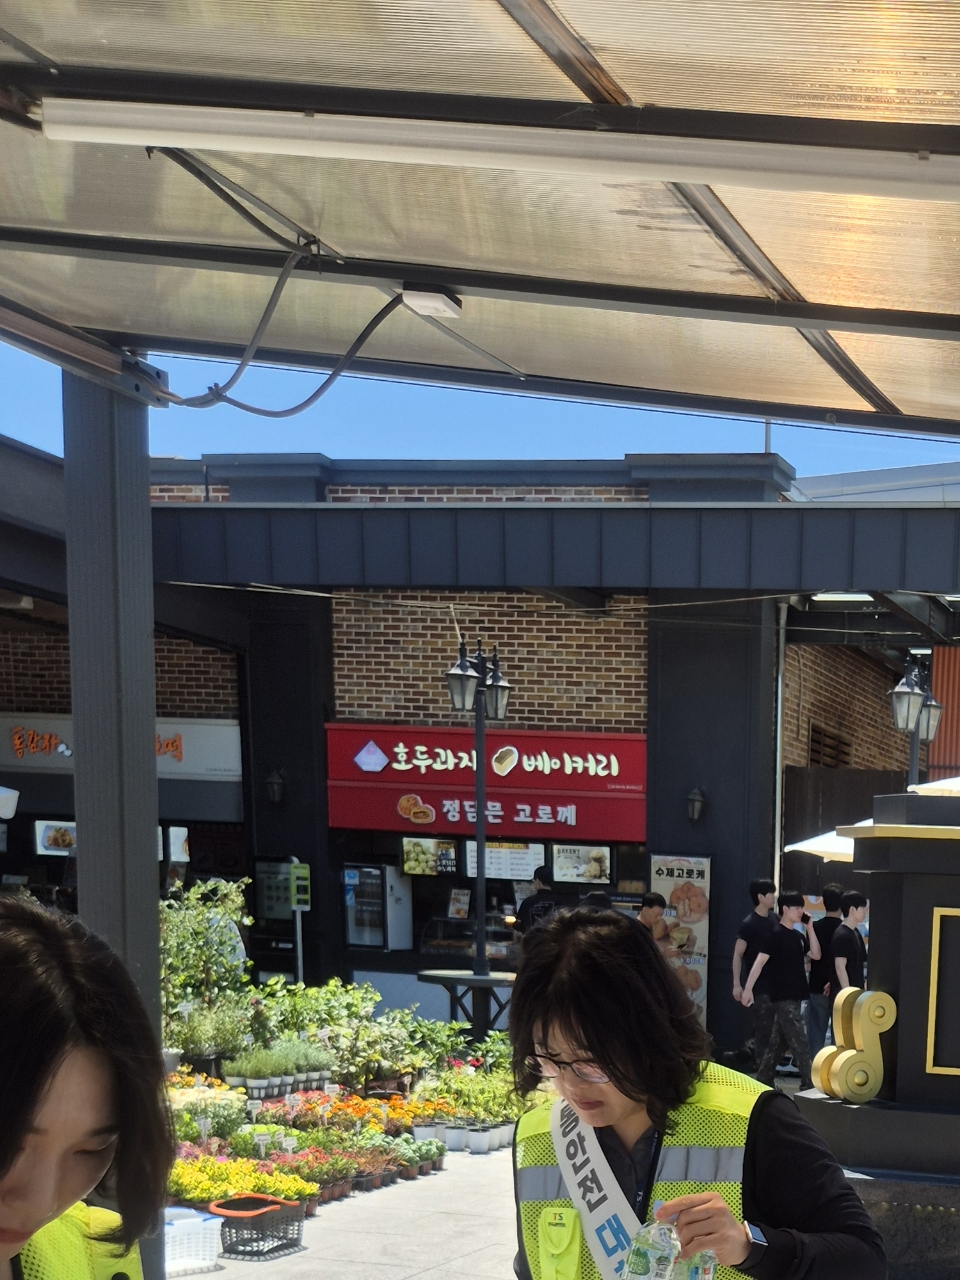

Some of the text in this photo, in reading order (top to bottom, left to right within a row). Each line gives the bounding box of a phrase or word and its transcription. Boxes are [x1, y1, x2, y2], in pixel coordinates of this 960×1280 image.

[391, 742, 620, 777] 호두과자 베이커리
[513, 803, 577, 826] 고로께
[655, 867, 706, 880] 수제고로케
[560, 1099, 608, 1214] 통안전
[552, 1212, 564, 1221] TS
